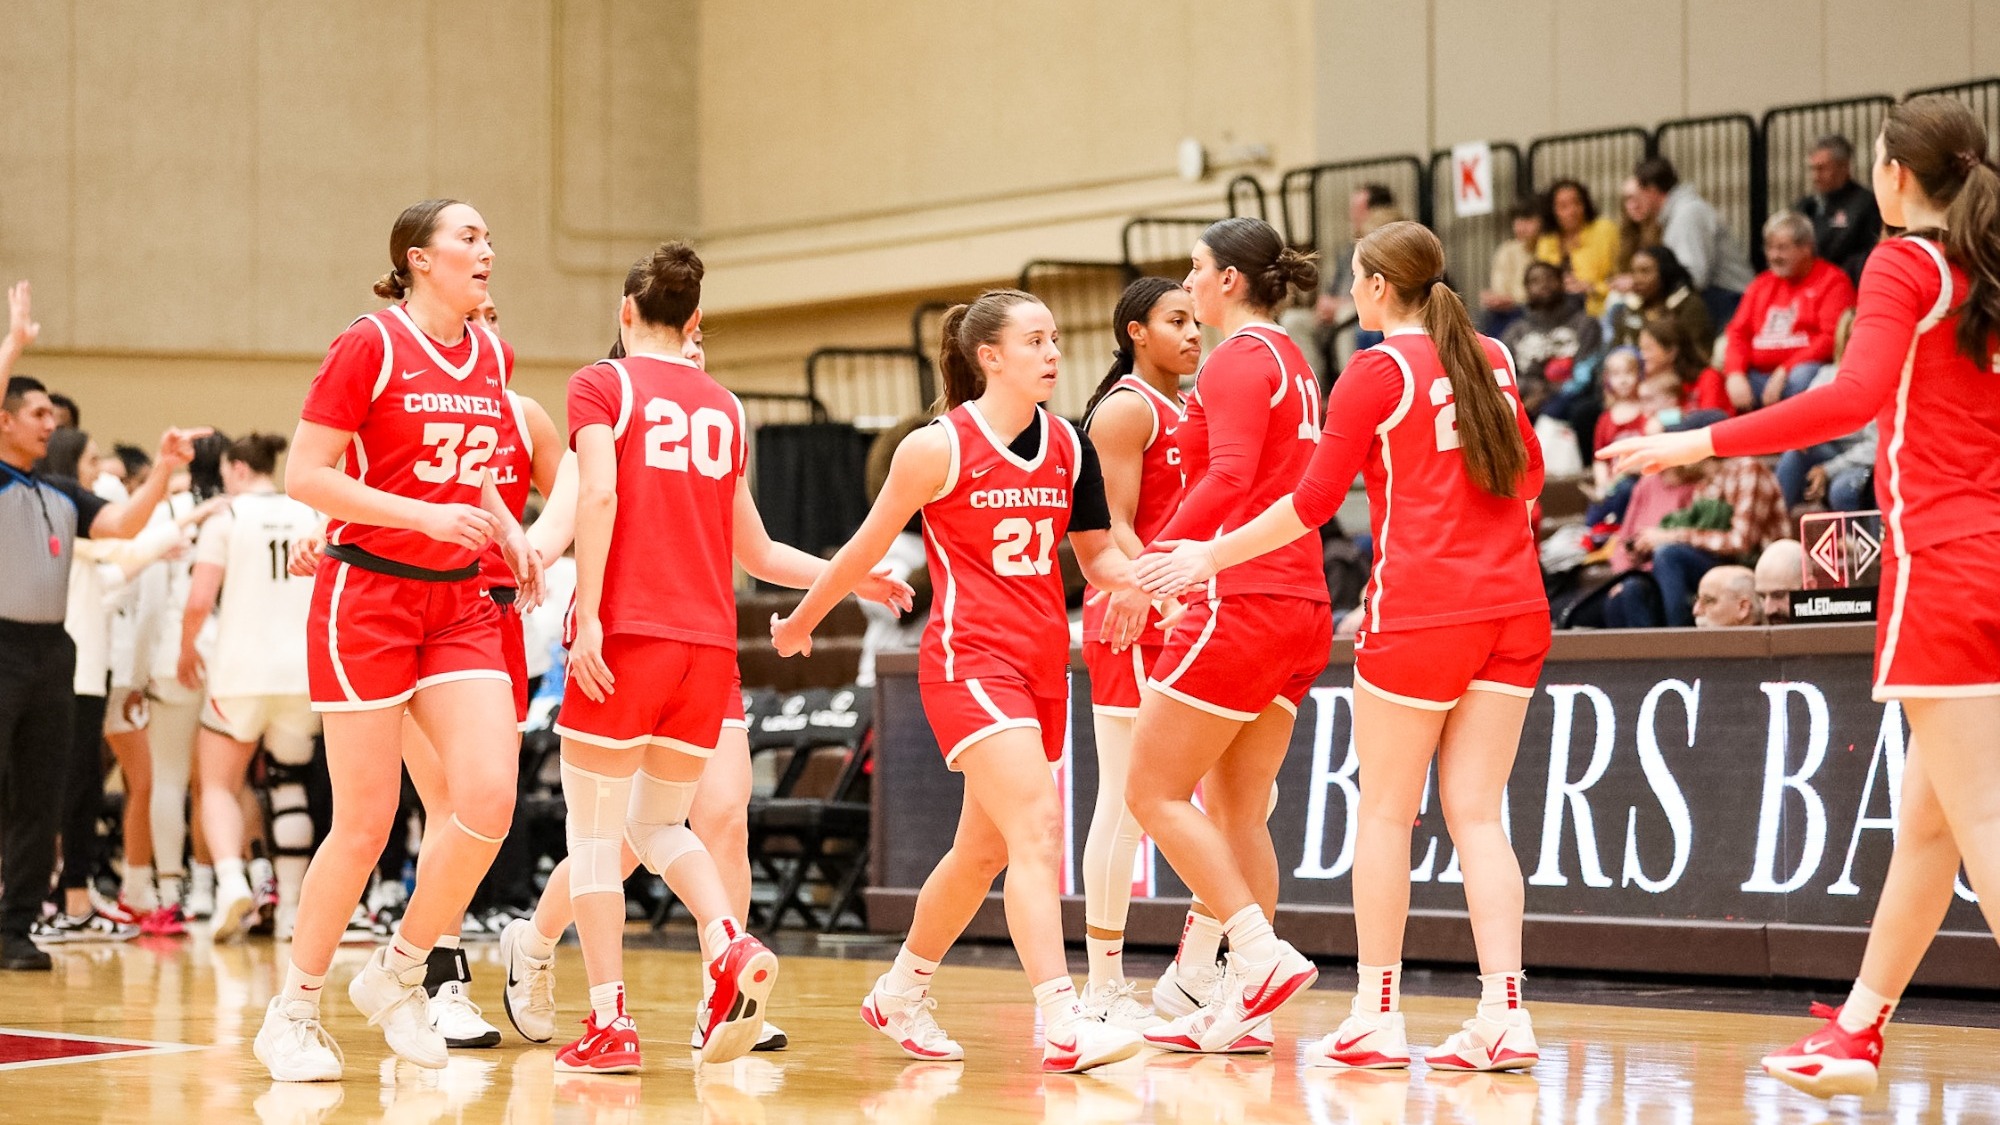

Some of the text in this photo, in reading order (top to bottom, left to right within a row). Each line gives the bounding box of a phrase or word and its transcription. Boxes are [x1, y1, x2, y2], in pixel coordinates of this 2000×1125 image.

[1460, 154, 1482, 199] K
[643, 396, 735, 481] 20
[1295, 373, 1322, 445] 11
[412, 421, 499, 488] 32
[969, 486, 1069, 509] CORNELL
[268, 539, 289, 580] 11
[991, 517, 1055, 577] 21
[1293, 678, 1701, 894] BRS
